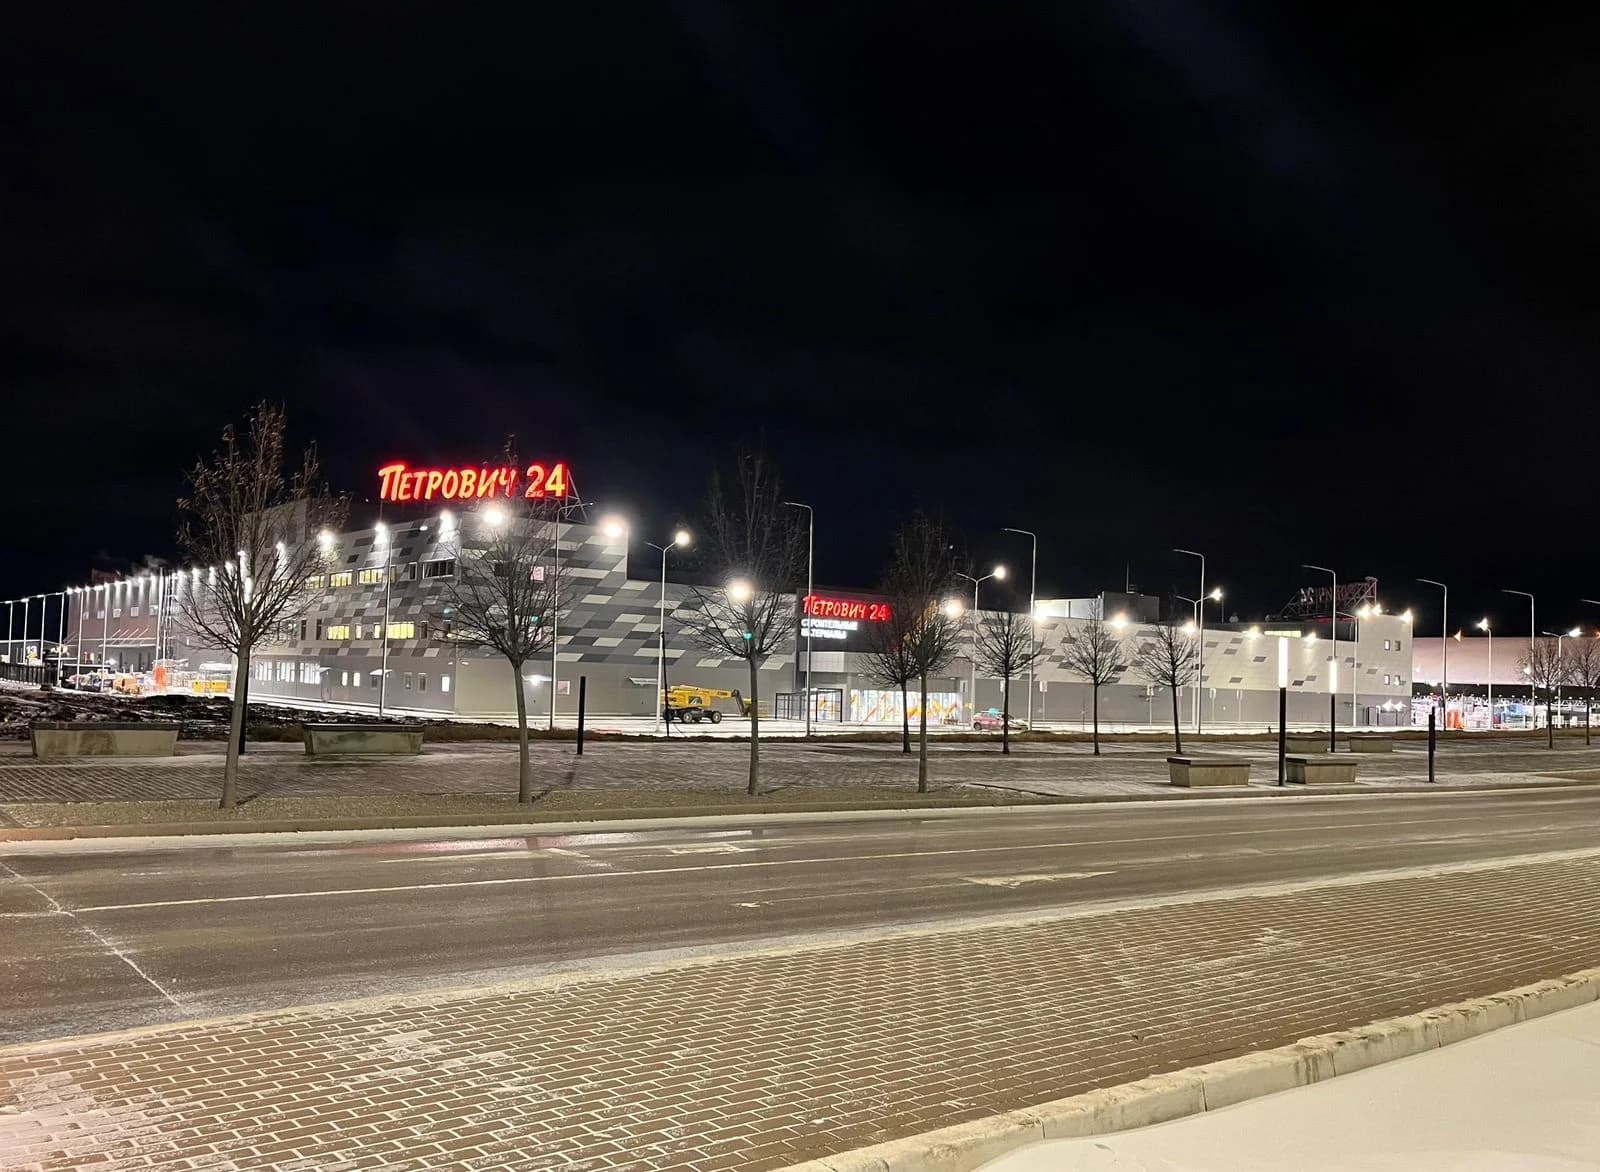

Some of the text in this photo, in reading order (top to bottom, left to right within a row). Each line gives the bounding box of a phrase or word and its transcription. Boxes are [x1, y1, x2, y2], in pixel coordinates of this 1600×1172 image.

[378, 464, 566, 501] ПЕТРОВИЧ 24
[802, 596, 888, 621] ПЕТРОВИЧ 24
